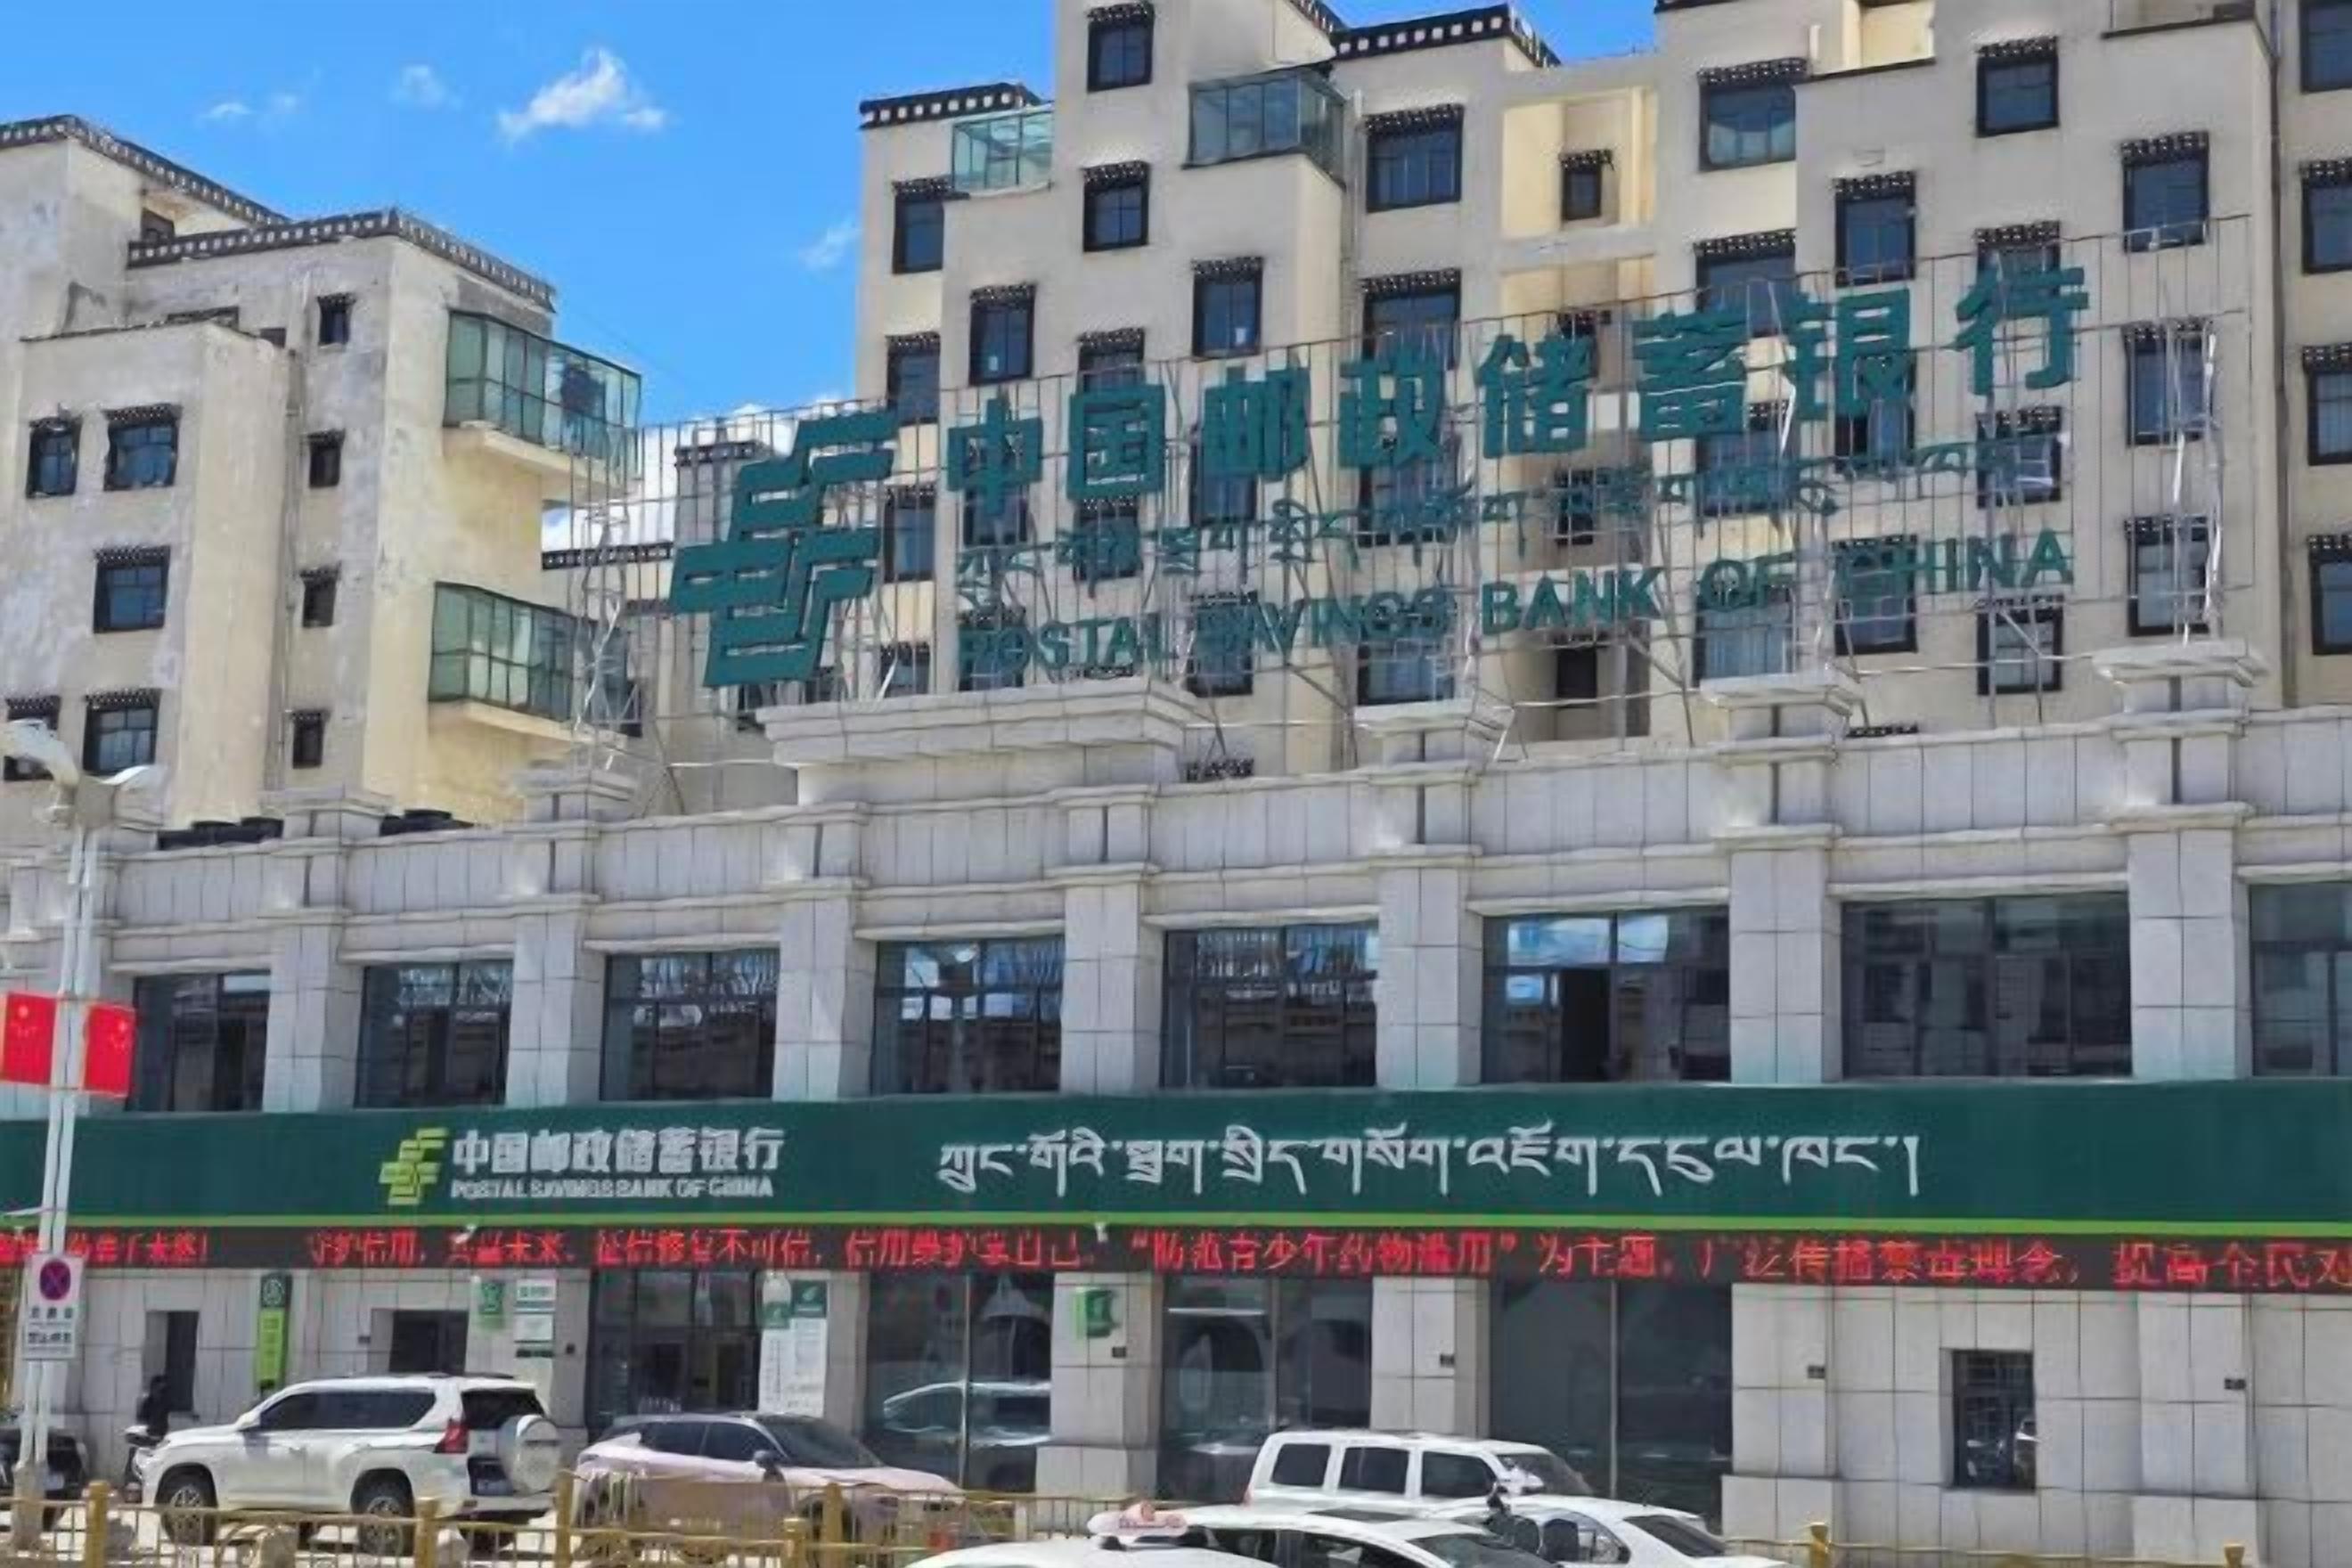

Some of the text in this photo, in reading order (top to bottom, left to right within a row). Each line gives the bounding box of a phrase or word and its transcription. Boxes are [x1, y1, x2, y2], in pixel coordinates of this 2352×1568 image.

[947, 265, 2090, 519] 中国邮政储蓄银行
[958, 615, 1180, 674] POSTAL
[1482, 567, 1665, 635] BANK
[1699, 551, 1798, 613] OF
[1836, 527, 2075, 599] CHINA
[450, 1178, 527, 1200] POSTAL
[615, 1177, 674, 1199] BANK
[676, 1177, 706, 1199] OF
[708, 1174, 774, 1198] CHINA
[453, 1126, 785, 1176] 中国邮政储蓄银行
